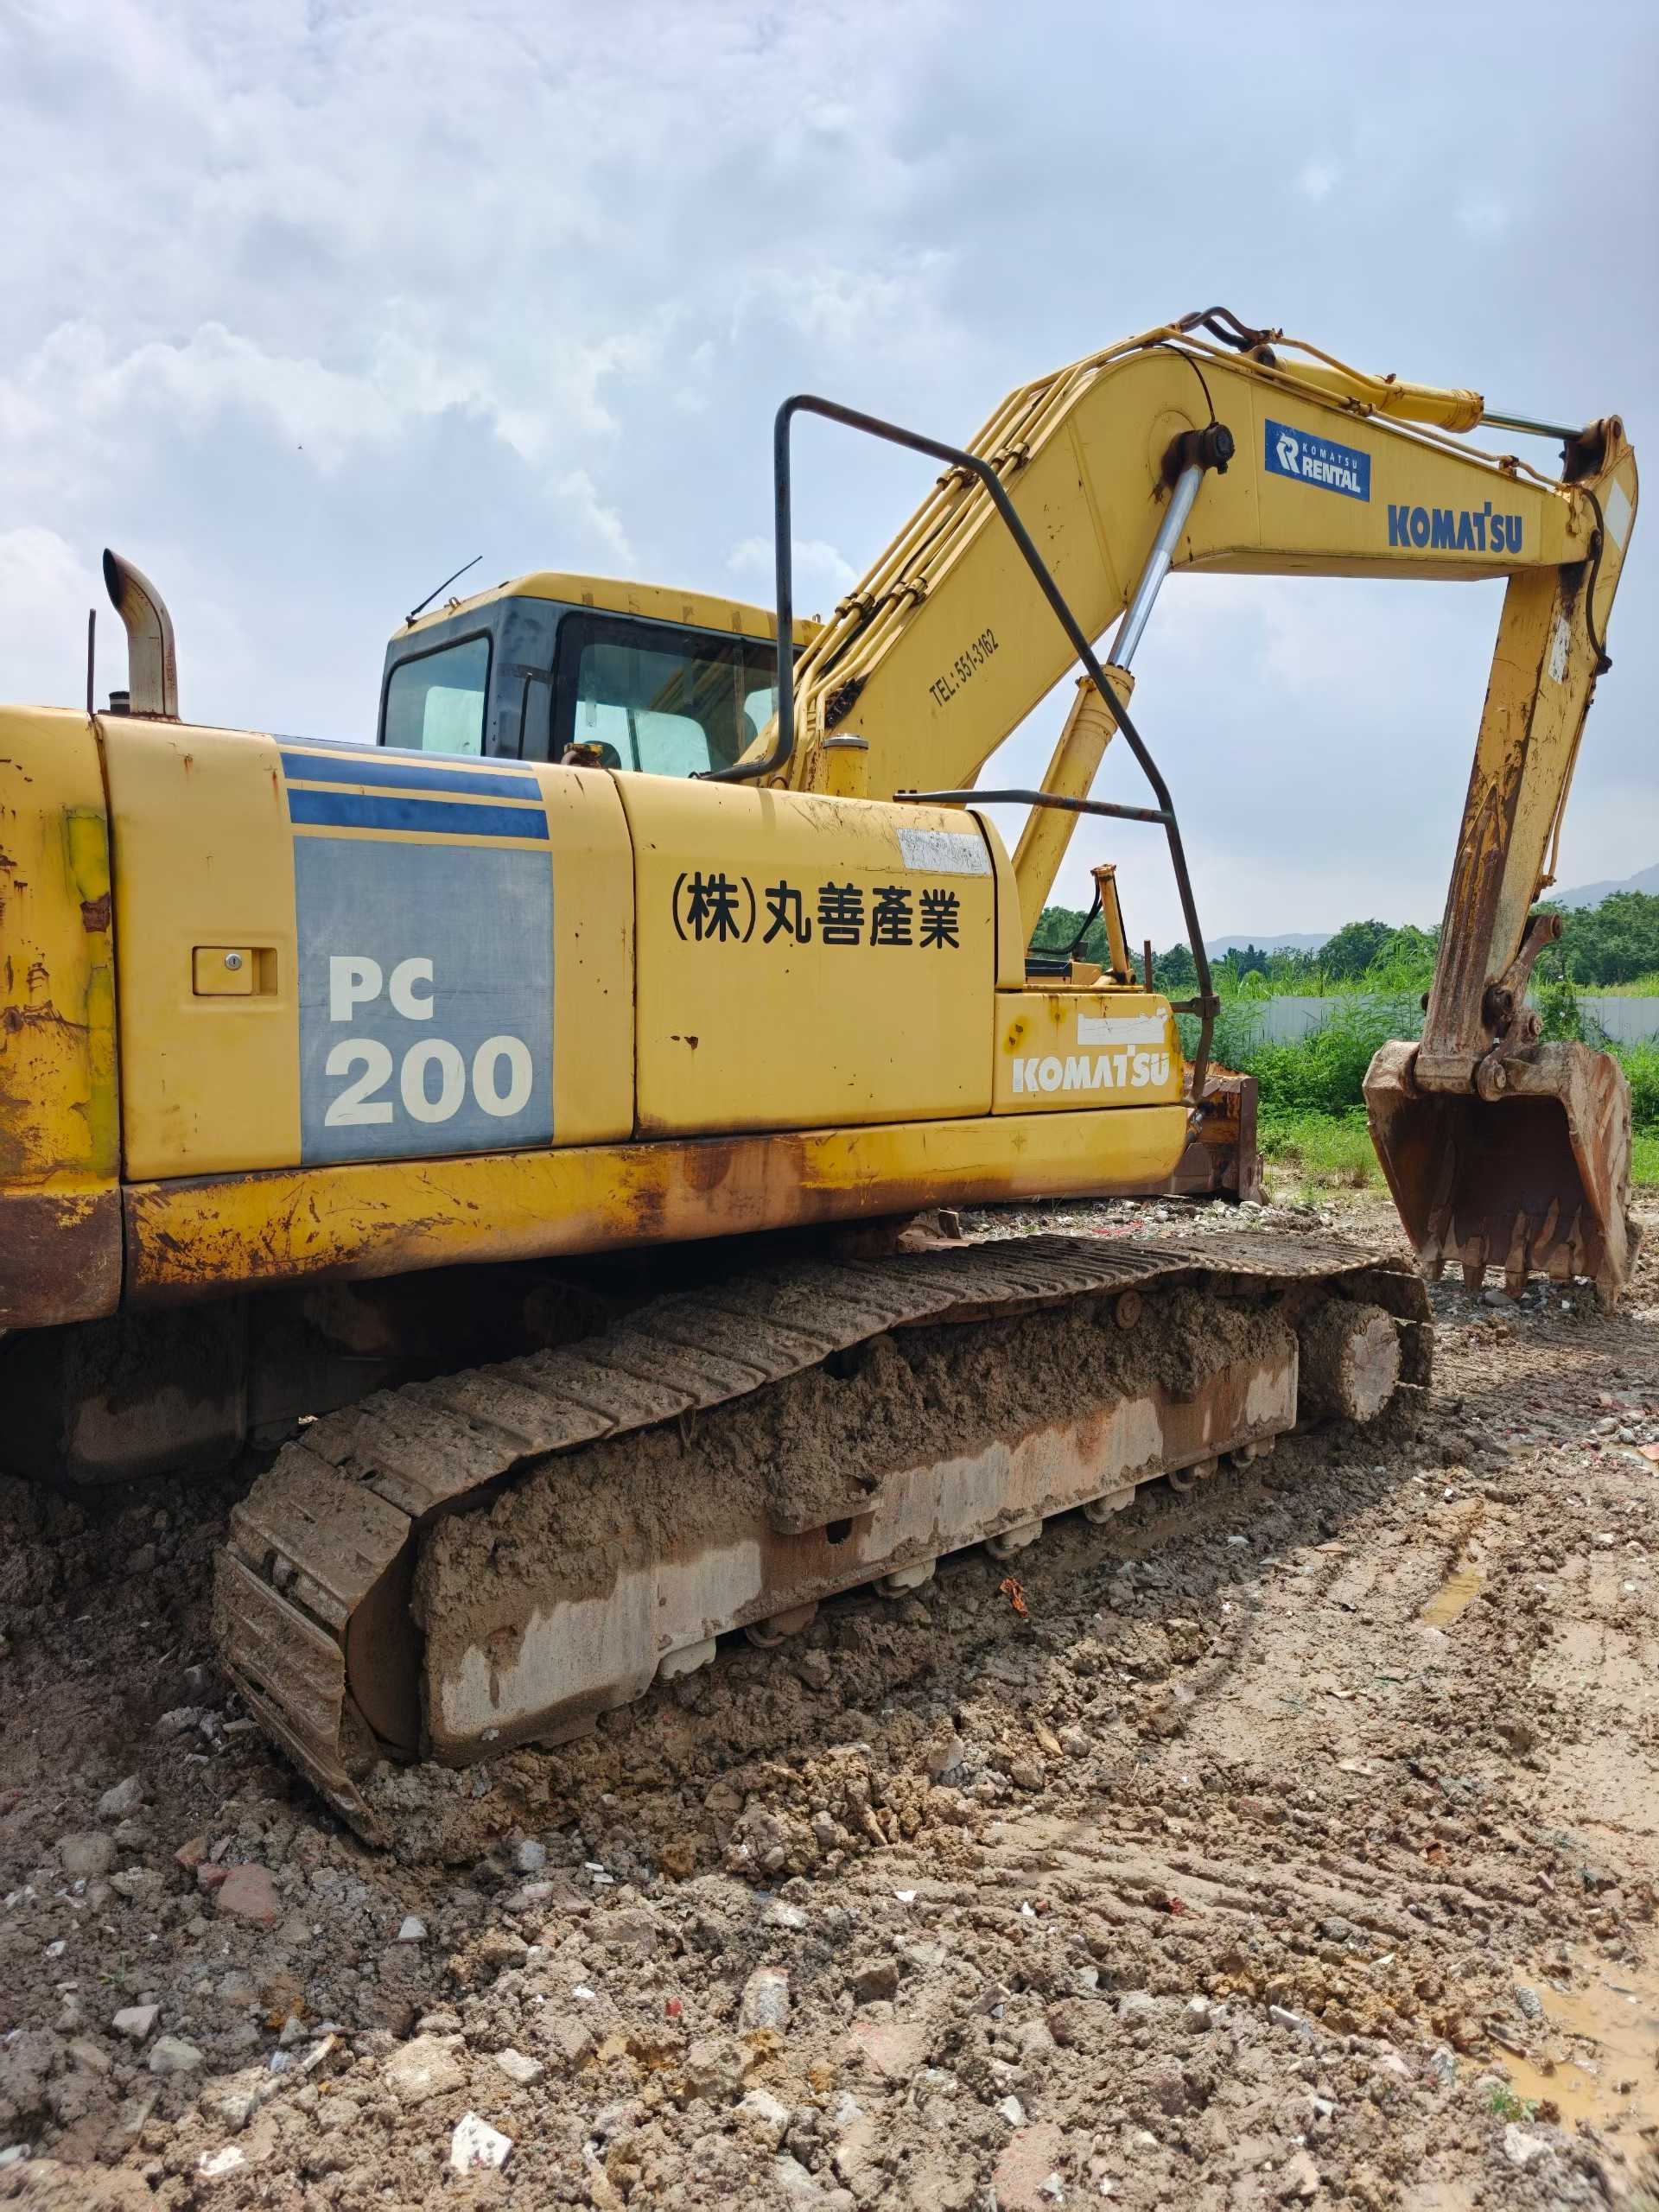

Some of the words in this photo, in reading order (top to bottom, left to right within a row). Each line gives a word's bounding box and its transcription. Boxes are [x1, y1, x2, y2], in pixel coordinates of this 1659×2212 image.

[1302, 442, 1357, 469] KOMATSU
[1302, 455, 1361, 493] RENTAL
[1388, 501, 1522, 554] KOMATSU
[329, 956, 434, 1021] PC
[324, 1035, 533, 1127] 200
[1013, 1044, 1170, 1093] KOMATSU
